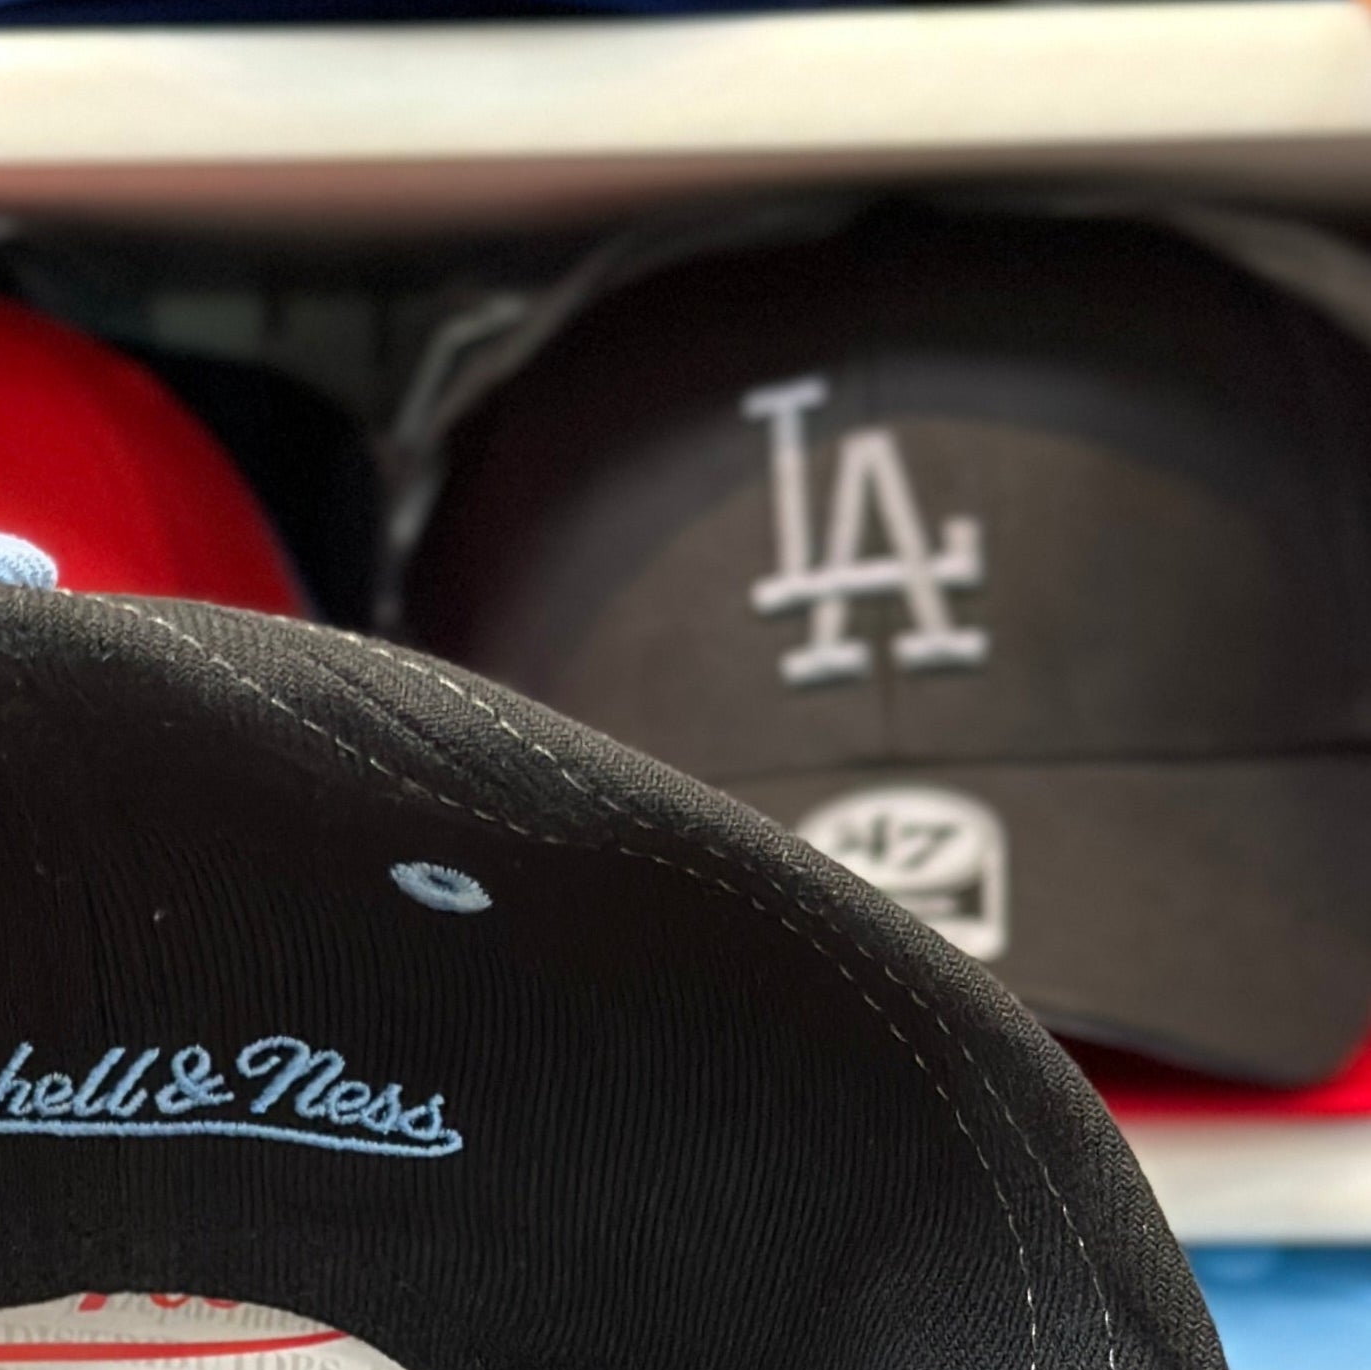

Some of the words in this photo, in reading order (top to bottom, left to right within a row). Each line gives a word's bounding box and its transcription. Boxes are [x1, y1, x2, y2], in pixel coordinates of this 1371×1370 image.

[742, 377, 989, 683] LA
[154, 1044, 235, 1115] &
[235, 1035, 446, 1142] Ness
